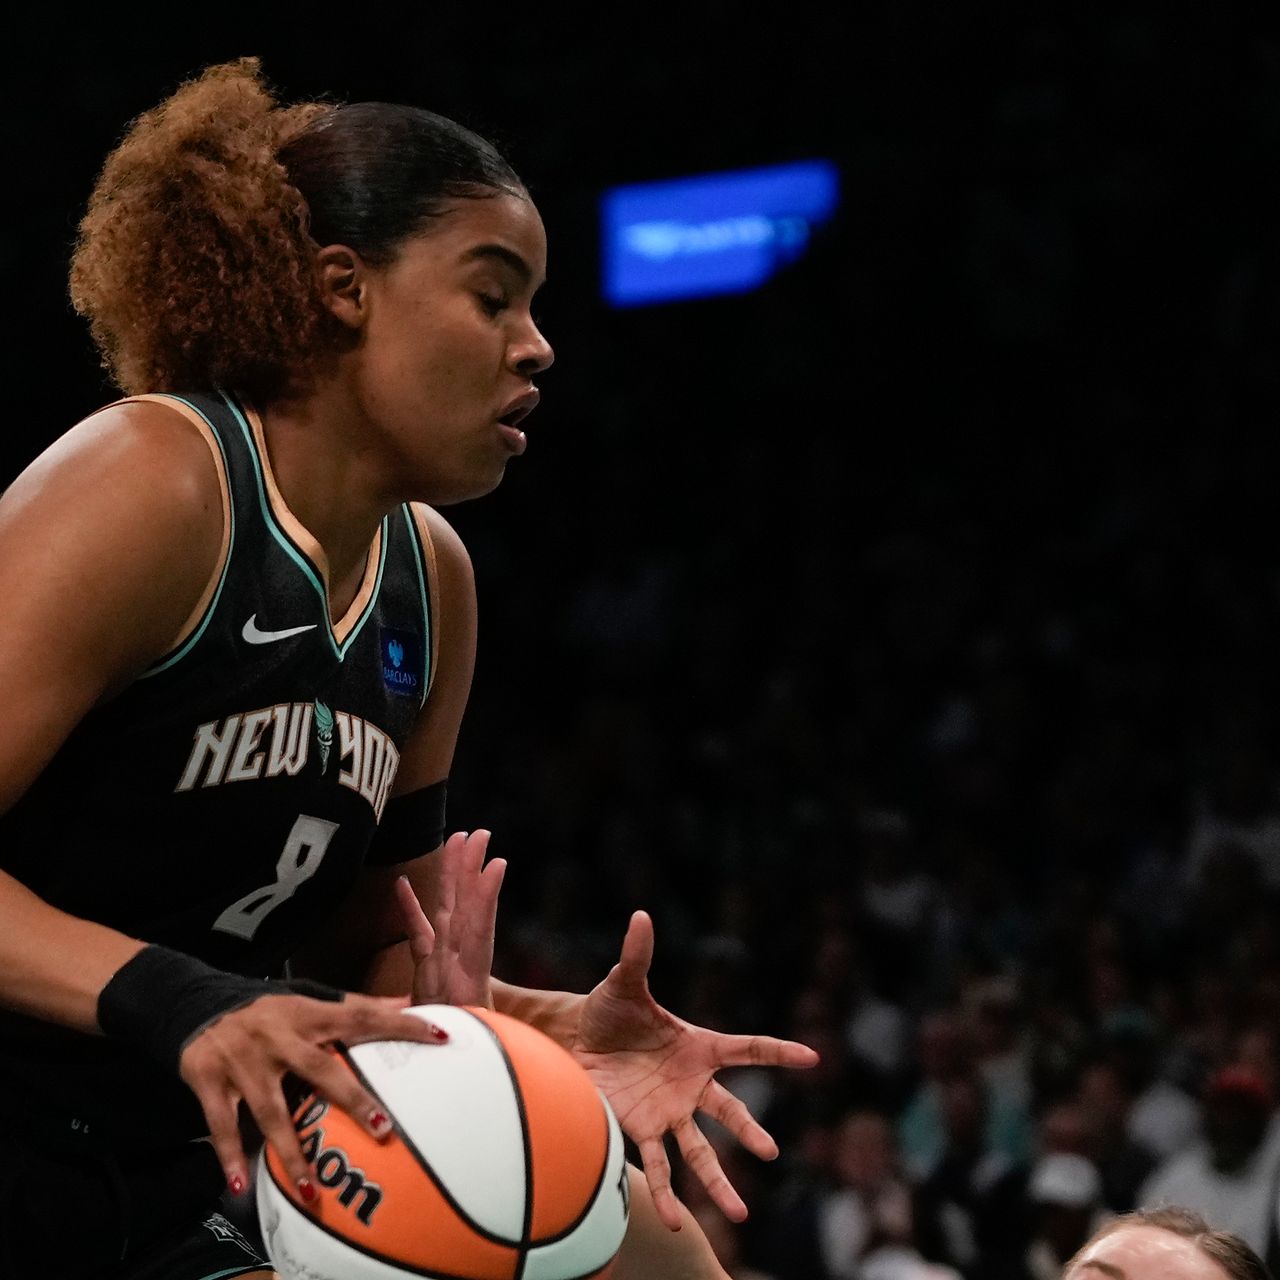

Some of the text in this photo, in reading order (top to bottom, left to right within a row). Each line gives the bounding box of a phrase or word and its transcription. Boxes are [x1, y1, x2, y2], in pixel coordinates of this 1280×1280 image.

[383, 666, 418, 687] BARCLAYS
[173, 702, 401, 826] NEW YOR
[211, 813, 341, 942] 8
